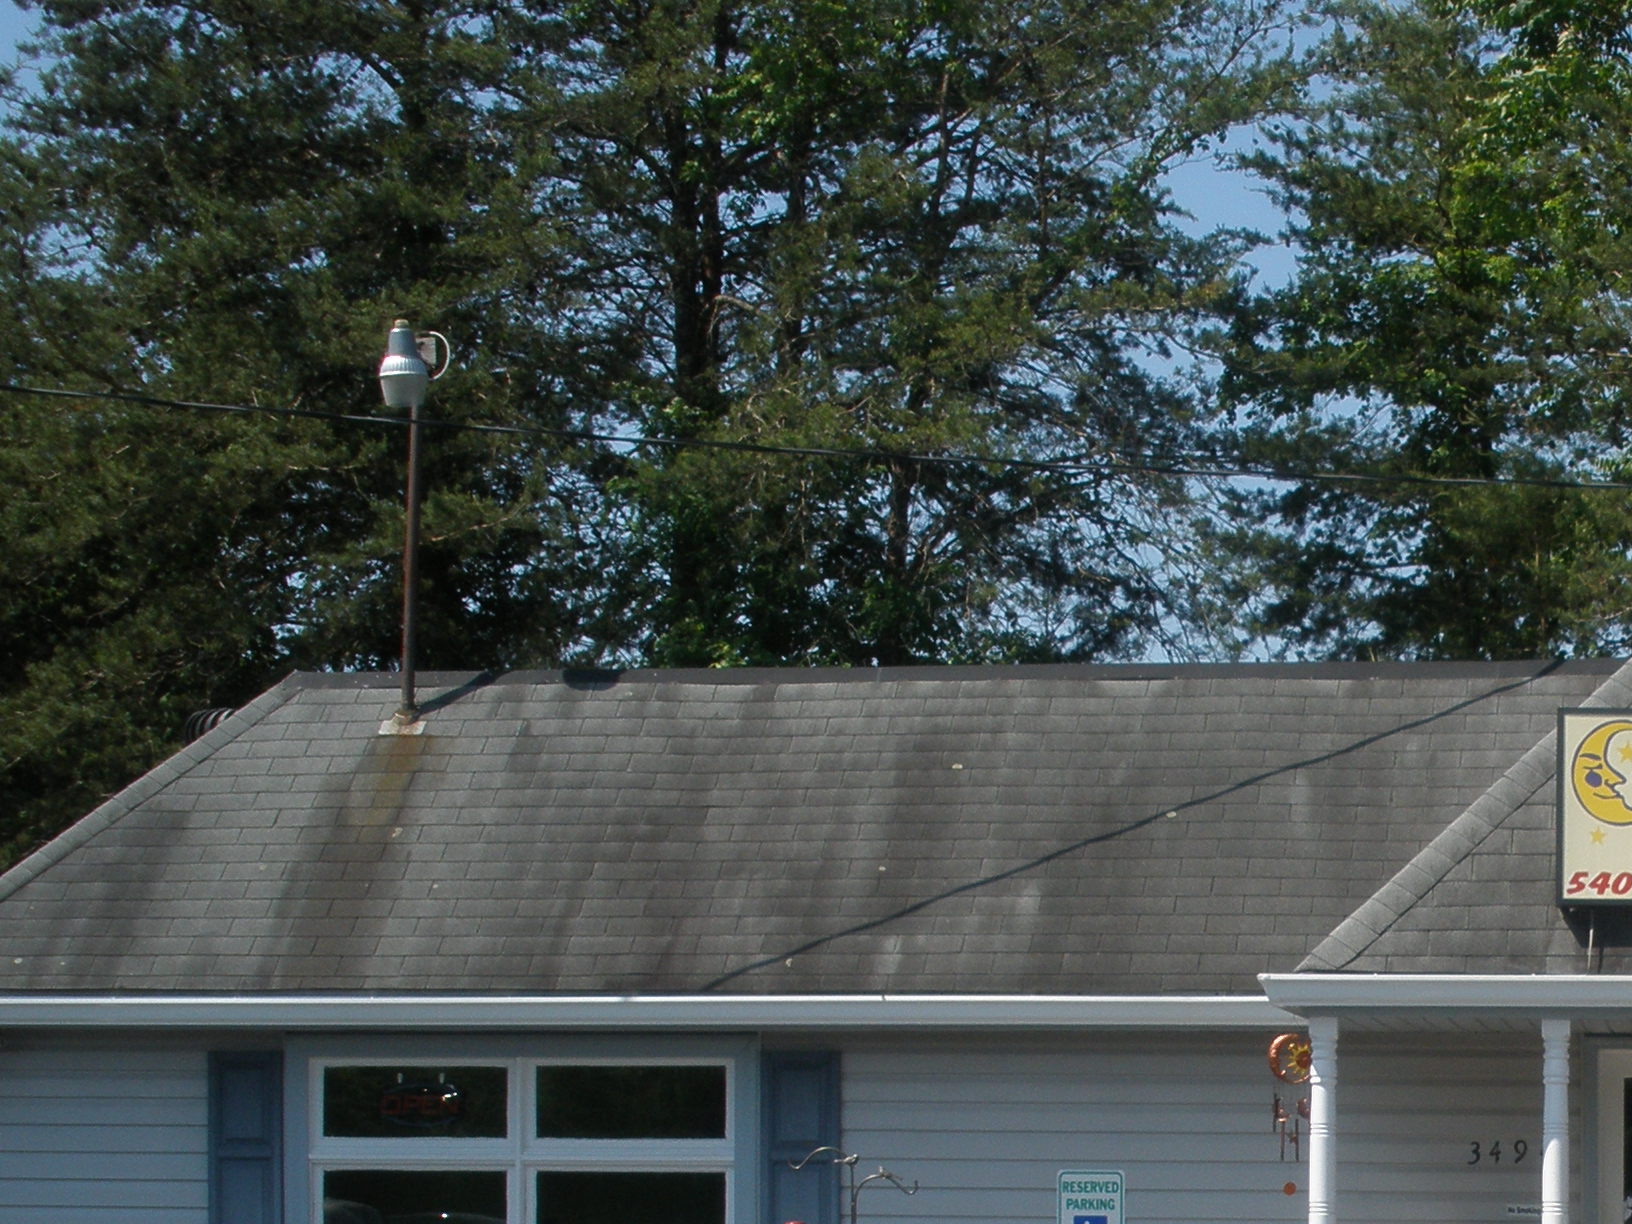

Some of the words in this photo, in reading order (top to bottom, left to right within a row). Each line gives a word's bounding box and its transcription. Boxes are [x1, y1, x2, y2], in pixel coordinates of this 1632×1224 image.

[1467, 1140, 1543, 1165] 349
[1062, 1181, 1119, 1194] RESERVED
[1066, 1199, 1115, 1211] PARKING
